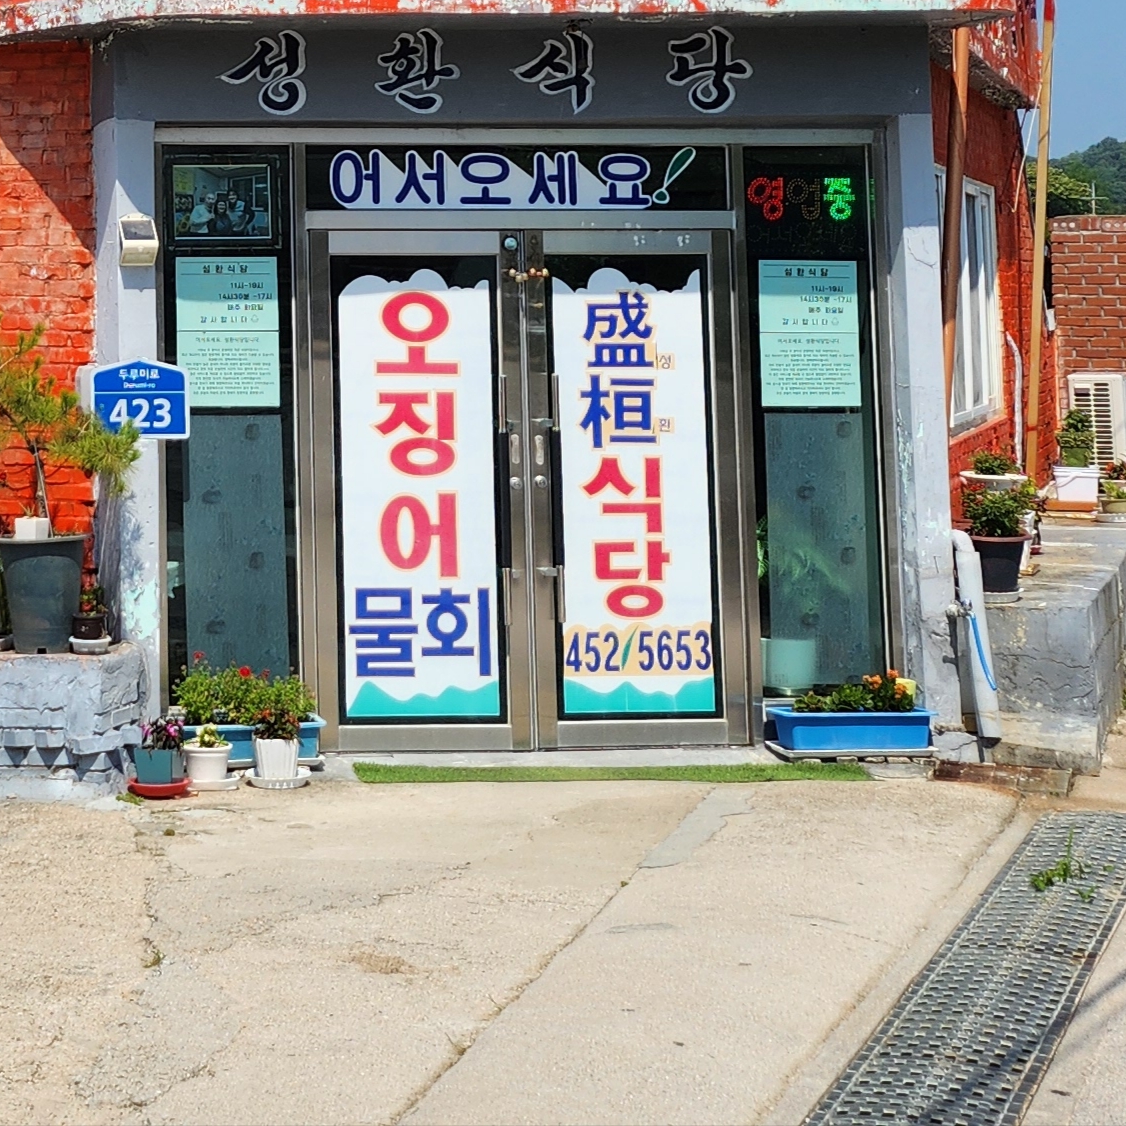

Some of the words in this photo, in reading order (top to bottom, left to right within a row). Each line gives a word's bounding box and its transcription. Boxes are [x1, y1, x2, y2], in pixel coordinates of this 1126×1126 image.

[747, 177, 856, 220] 영업중
[109, 398, 172, 428] 423
[348, 587, 492, 677] 물회
